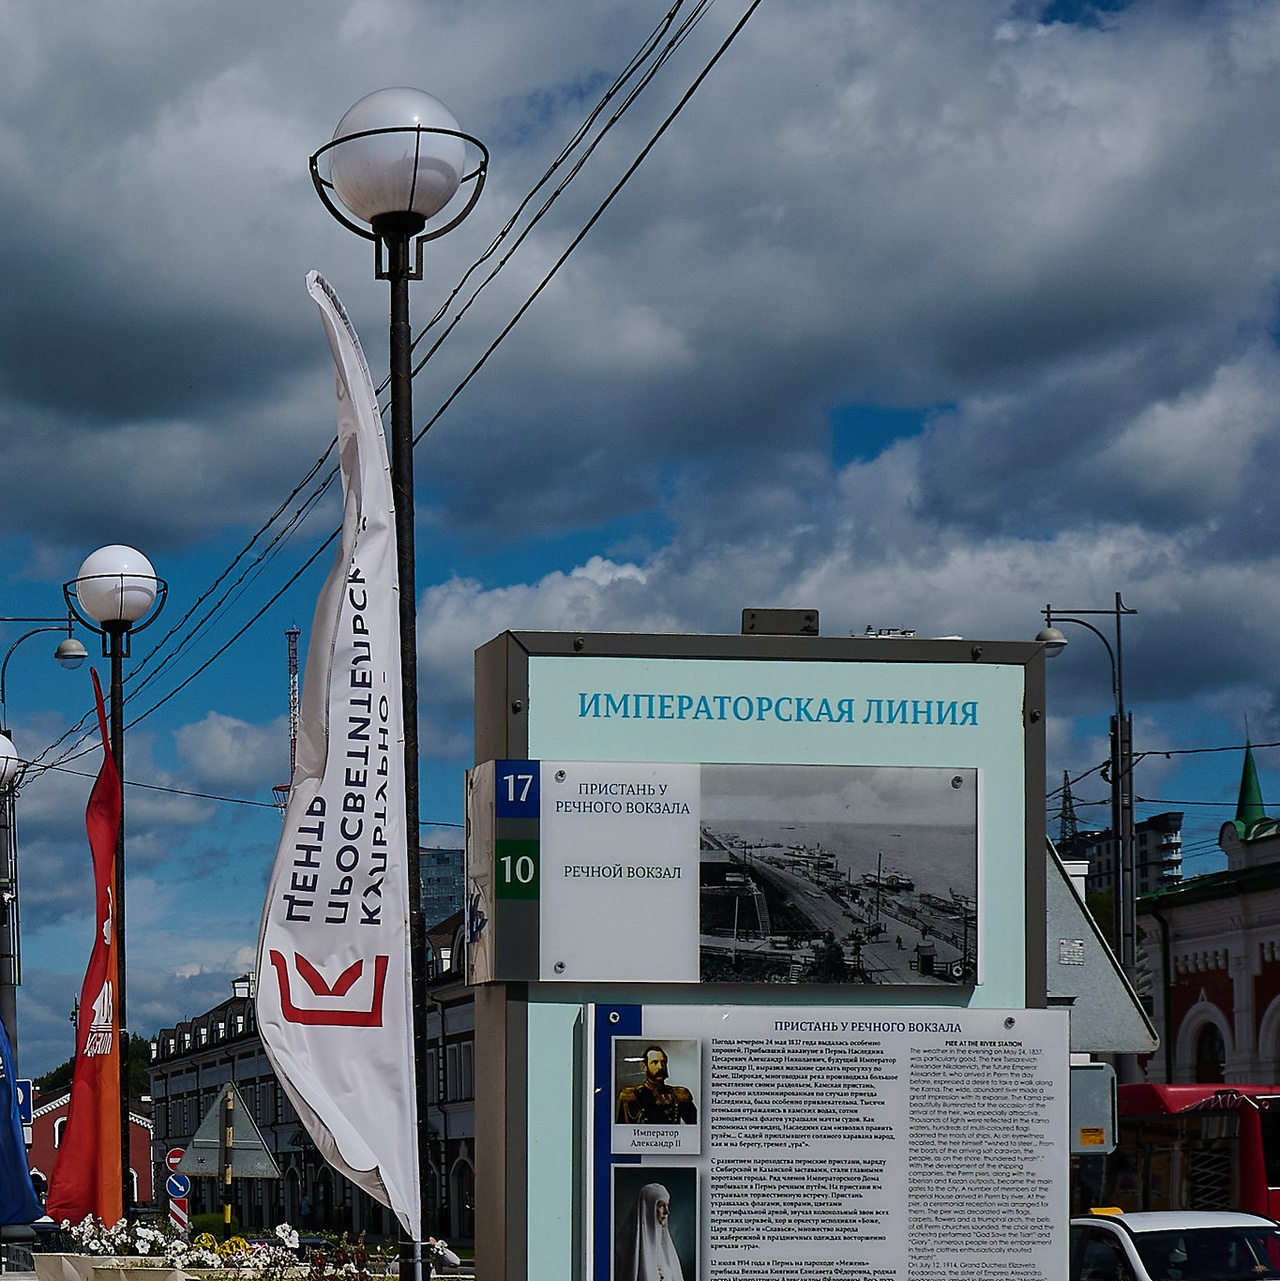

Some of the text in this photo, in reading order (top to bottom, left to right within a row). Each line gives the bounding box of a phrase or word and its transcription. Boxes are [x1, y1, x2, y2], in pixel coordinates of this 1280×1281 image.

[577, 692, 980, 726] ИМПЕРАТОРСКАЯ ЛИНИЯ
[503, 772, 533, 803] 17
[579, 783, 668, 796] ПРИСТАНЬ У
[556, 801, 690, 814] РЕЧНОГО ВОКЗАЛА
[500, 854, 535, 883] 10
[564, 864, 681, 879] РЕЧНОЙ ВОКЗАЛ
[775, 1021, 962, 1033] ПРИСТАНЬ У РЕЧНОГО ВОКЗАЛА
[633, 1129, 679, 1138] Император
[630, 1140, 674, 1149] Александр
